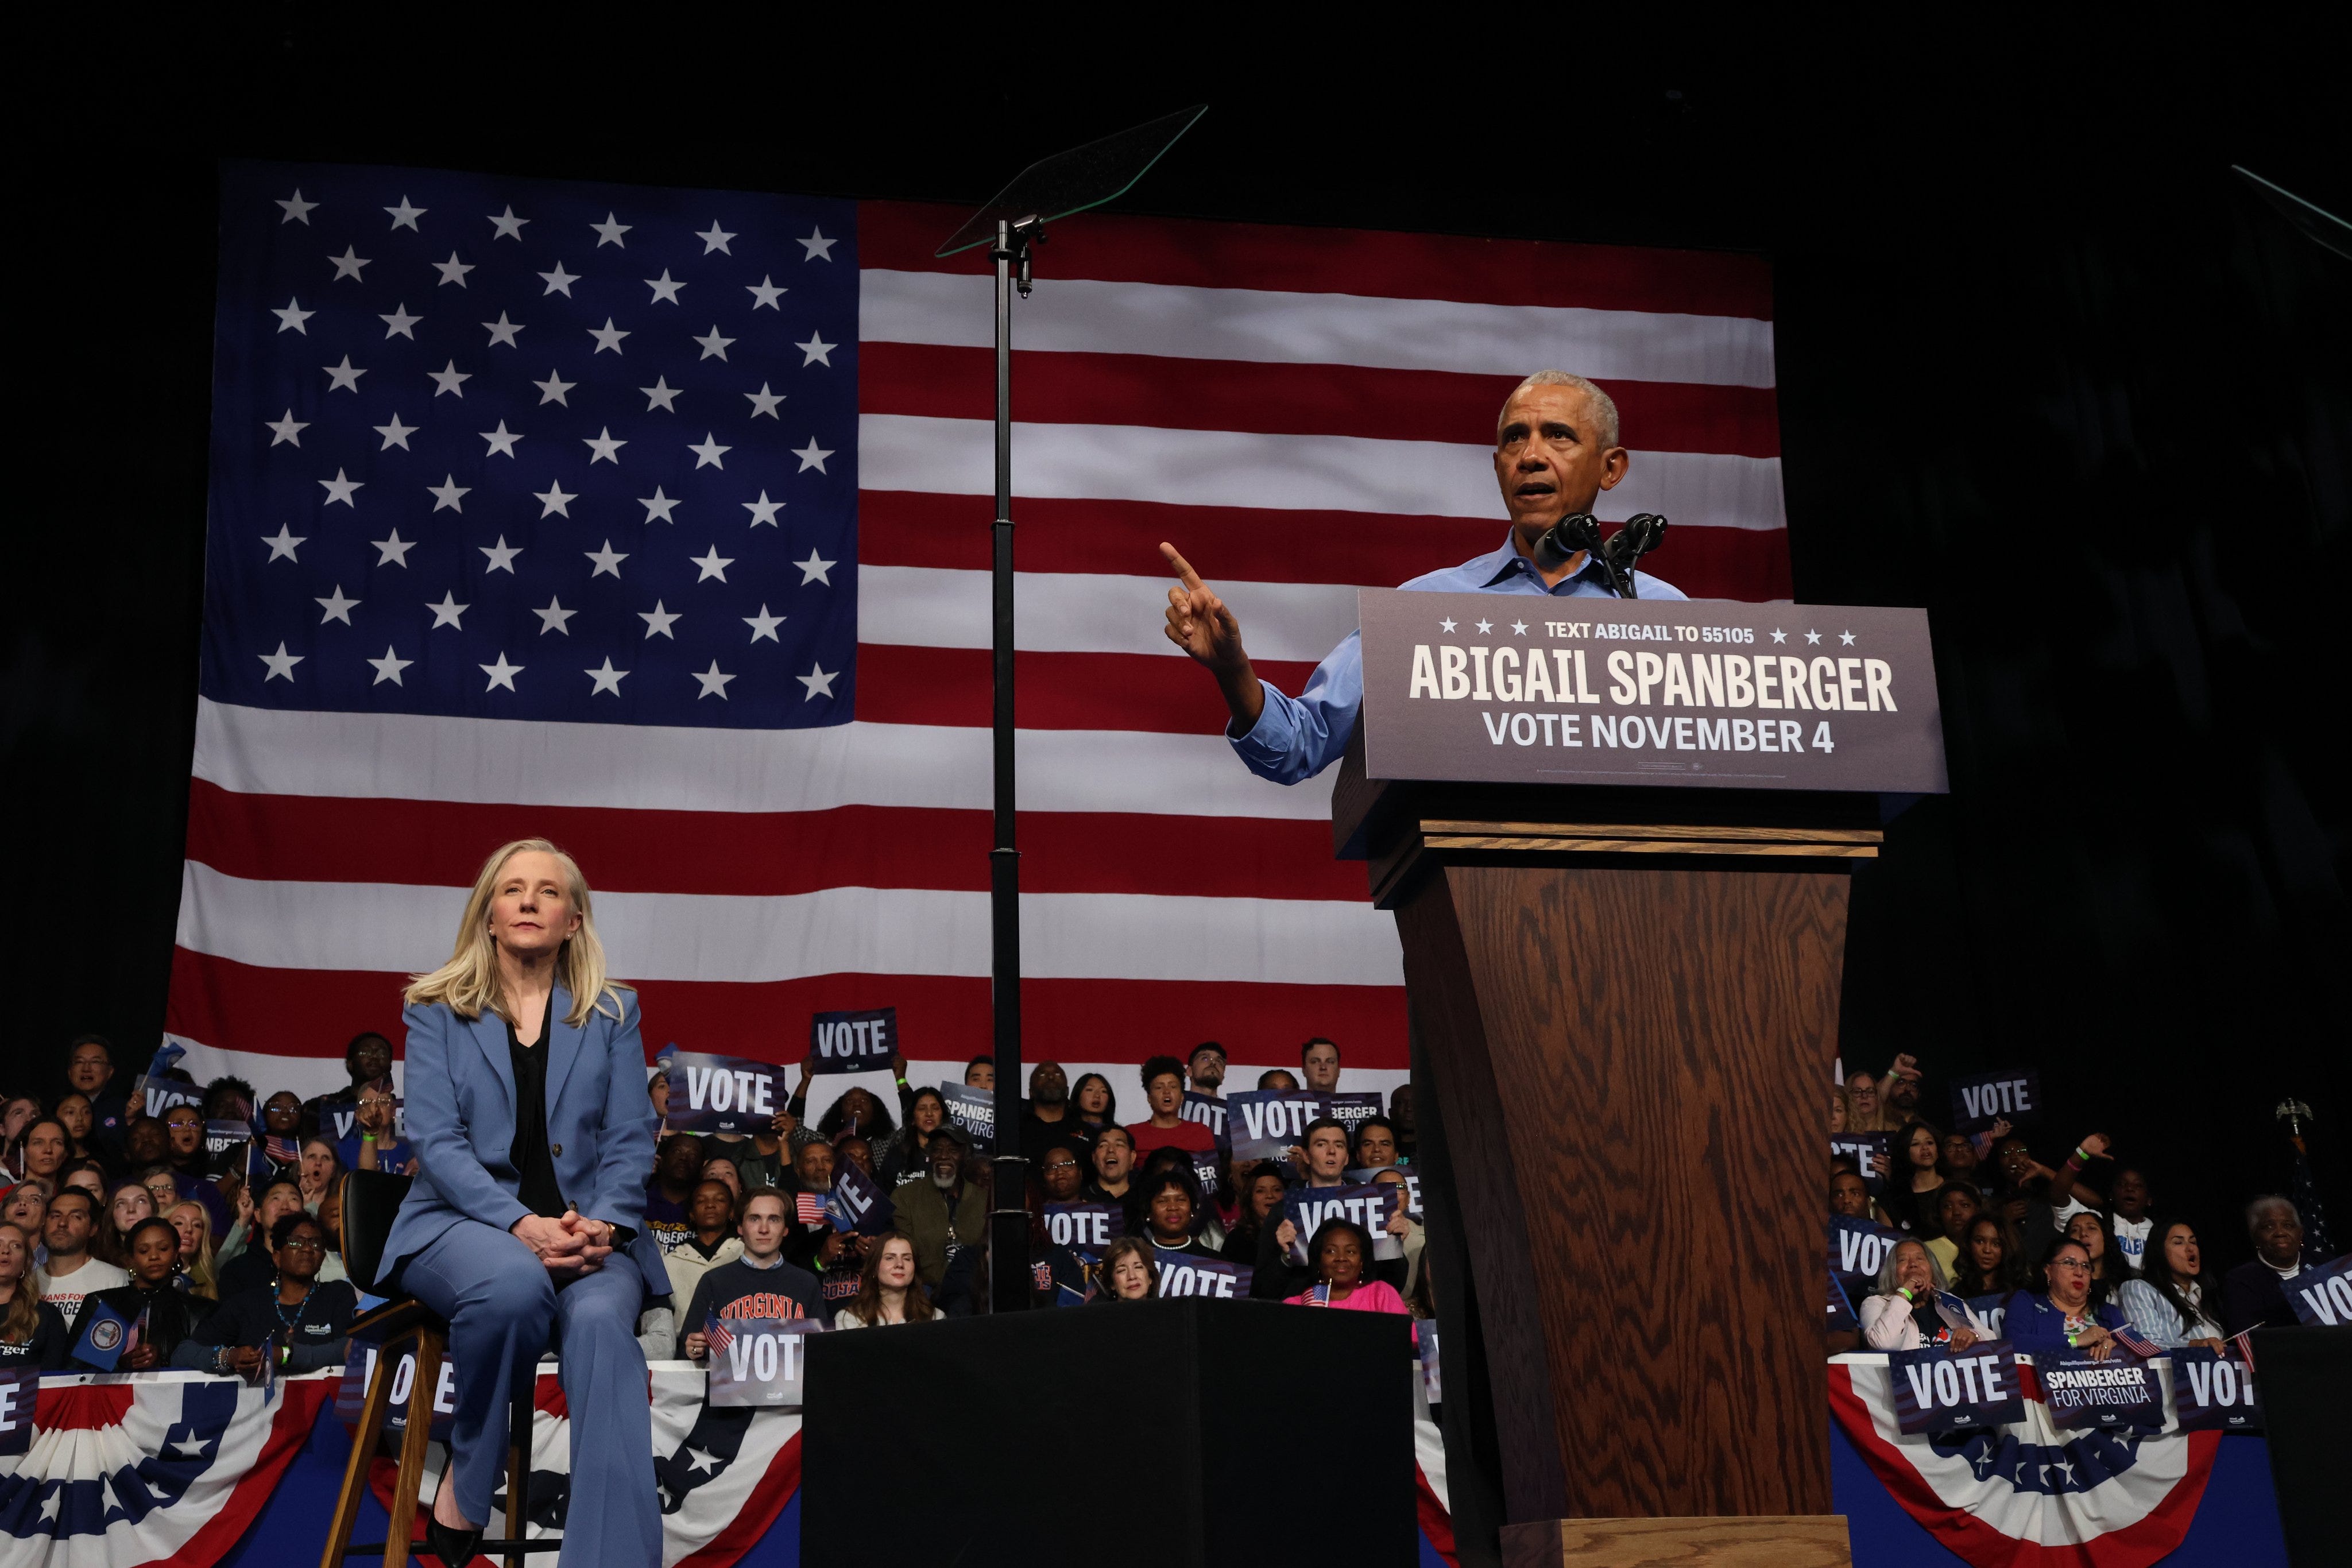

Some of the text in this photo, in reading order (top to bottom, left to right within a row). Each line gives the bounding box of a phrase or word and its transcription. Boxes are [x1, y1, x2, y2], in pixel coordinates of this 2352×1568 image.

[1545, 621, 1754, 644] TEXT ABIGAIL TO 55105
[1409, 644, 1898, 712] ABIGAIL SPANBERGER
[1481, 712, 1835, 753] VOTE NOVEMBER 4
[818, 1019, 888, 1058] VOTE
[687, 1066, 773, 1115] VOTE
[1962, 1079, 2032, 1118] VOTE
[945, 1099, 994, 1124] SPANBE
[1178, 1100, 1227, 1136] VOT
[1241, 1100, 1320, 1140] VOTE
[1331, 1106, 1378, 1120] BERGER
[1831, 1141, 1876, 1178] TE
[835, 1172, 873, 1224] TE
[1154, 1260, 1237, 1298] VOTE
[2299, 1270, 2352, 1326] VO
[719, 1292, 805, 1319] VIRGINIA
[728, 1333, 804, 1382] VOT
[1905, 1354, 2008, 1410] VOTE
[2046, 1367, 2146, 1389] SPANBERGER
[2053, 1385, 2152, 1407] FOR VIRGINIA
[2185, 1360, 2254, 1407] VOT
